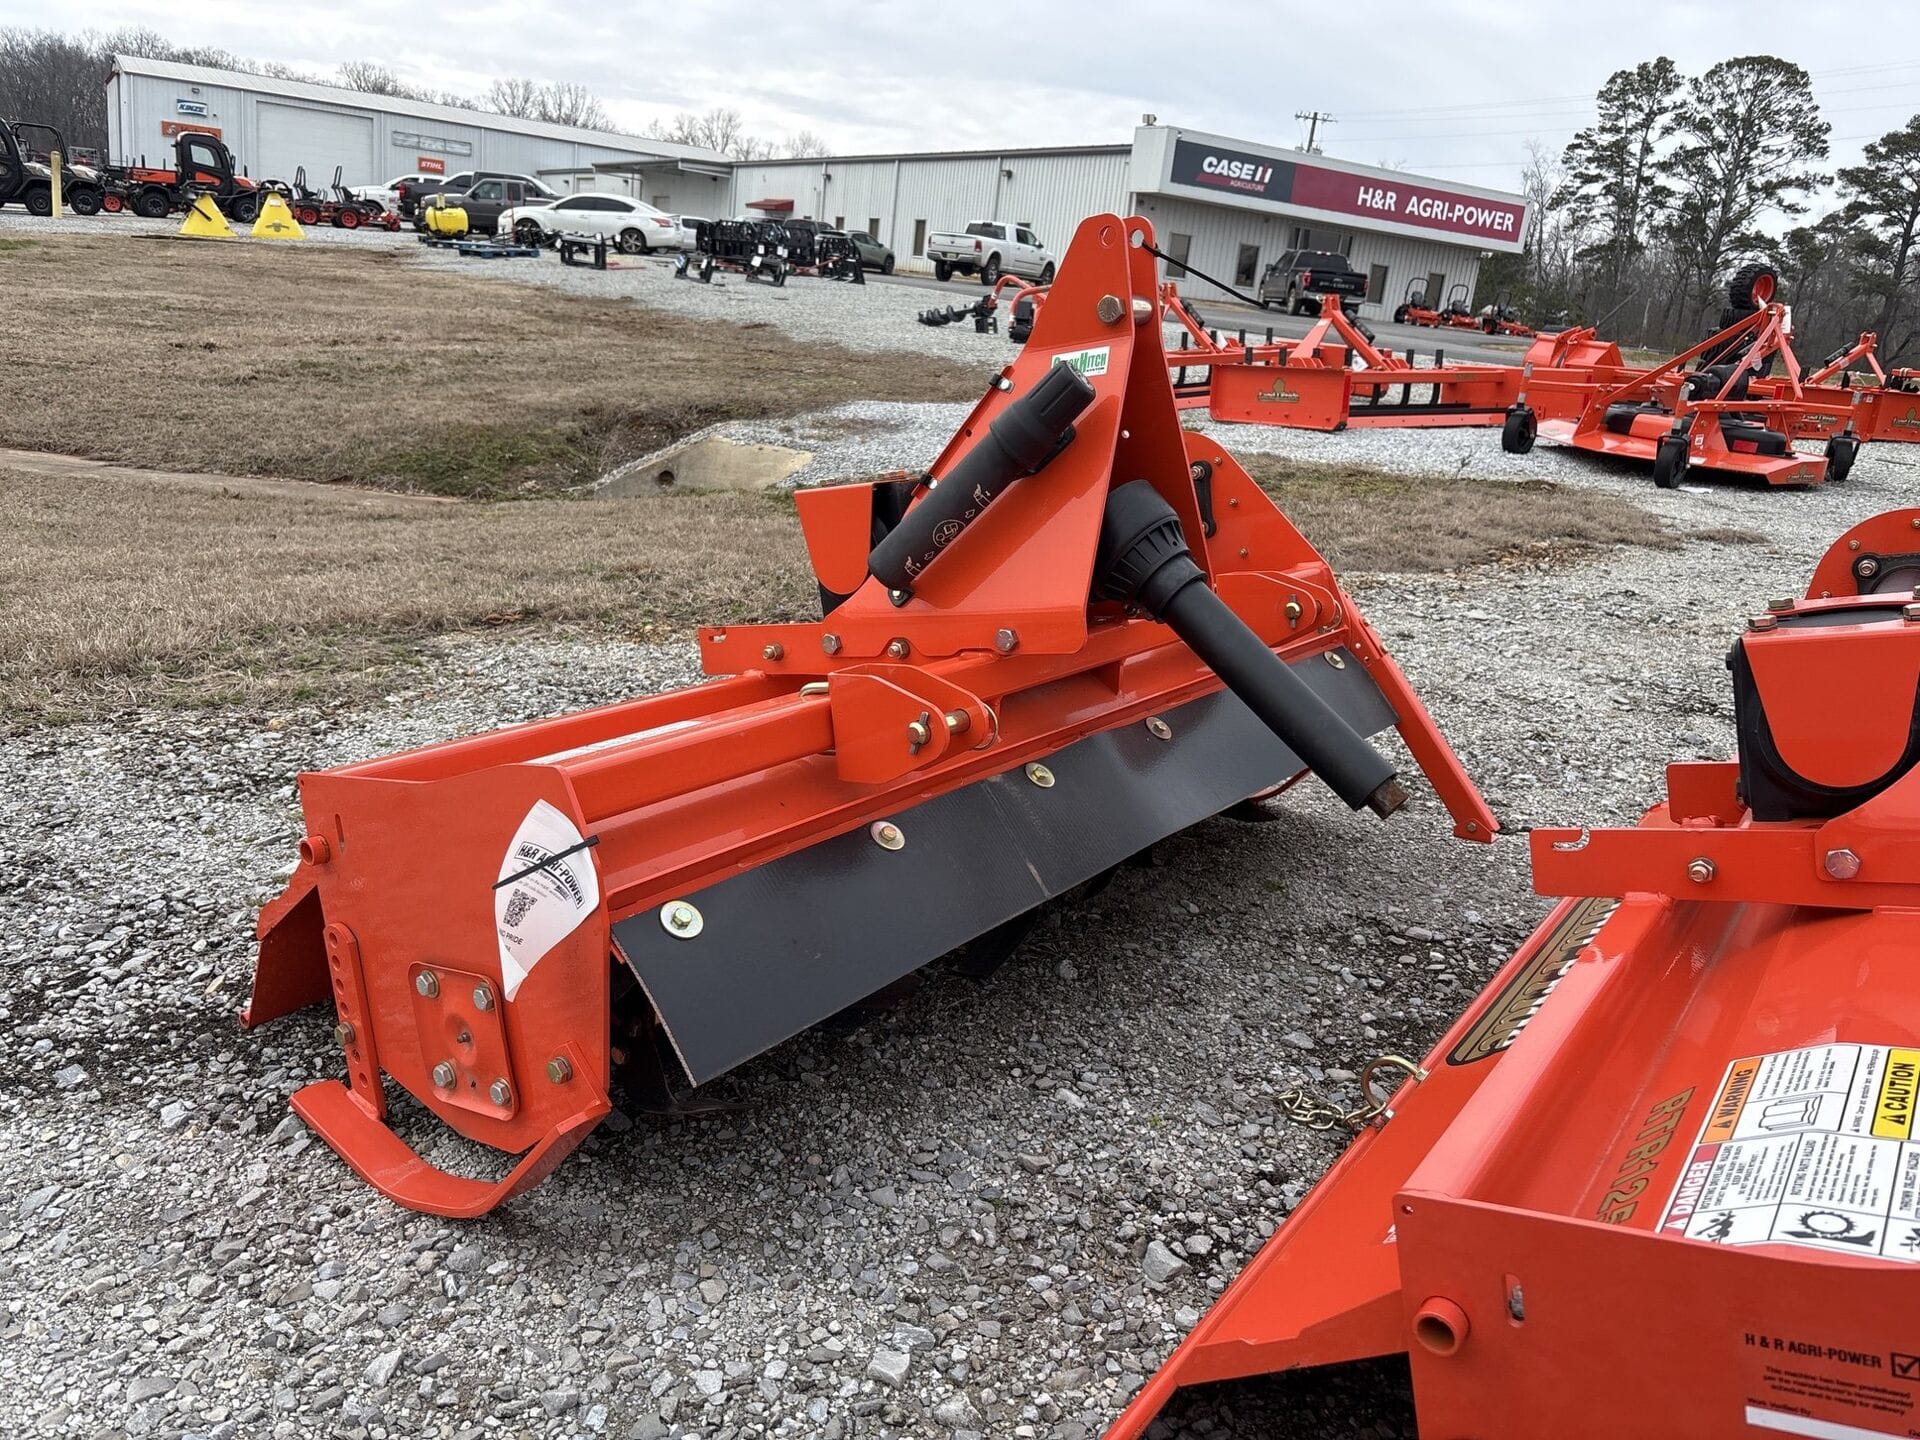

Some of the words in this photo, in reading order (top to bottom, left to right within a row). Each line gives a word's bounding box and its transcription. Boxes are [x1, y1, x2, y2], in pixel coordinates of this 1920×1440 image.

[421, 161, 444, 170] STIHL
[1203, 156, 1256, 180] CASE
[1230, 179, 1265, 193] AGRICULTURE
[1357, 186, 1397, 212] H&R
[1405, 196, 1514, 232] AGRI-POWER
[1718, 1069, 1754, 1119] WARNING
[1884, 1062, 1916, 1111] CAUTION
[1672, 1159, 1712, 1217] DANGER
[1745, 1333, 1755, 1345] H
[1760, 1336, 1770, 1348] &
[1774, 1338, 1784, 1351] R
[1788, 1341, 1882, 1369] AGRI-POWER
